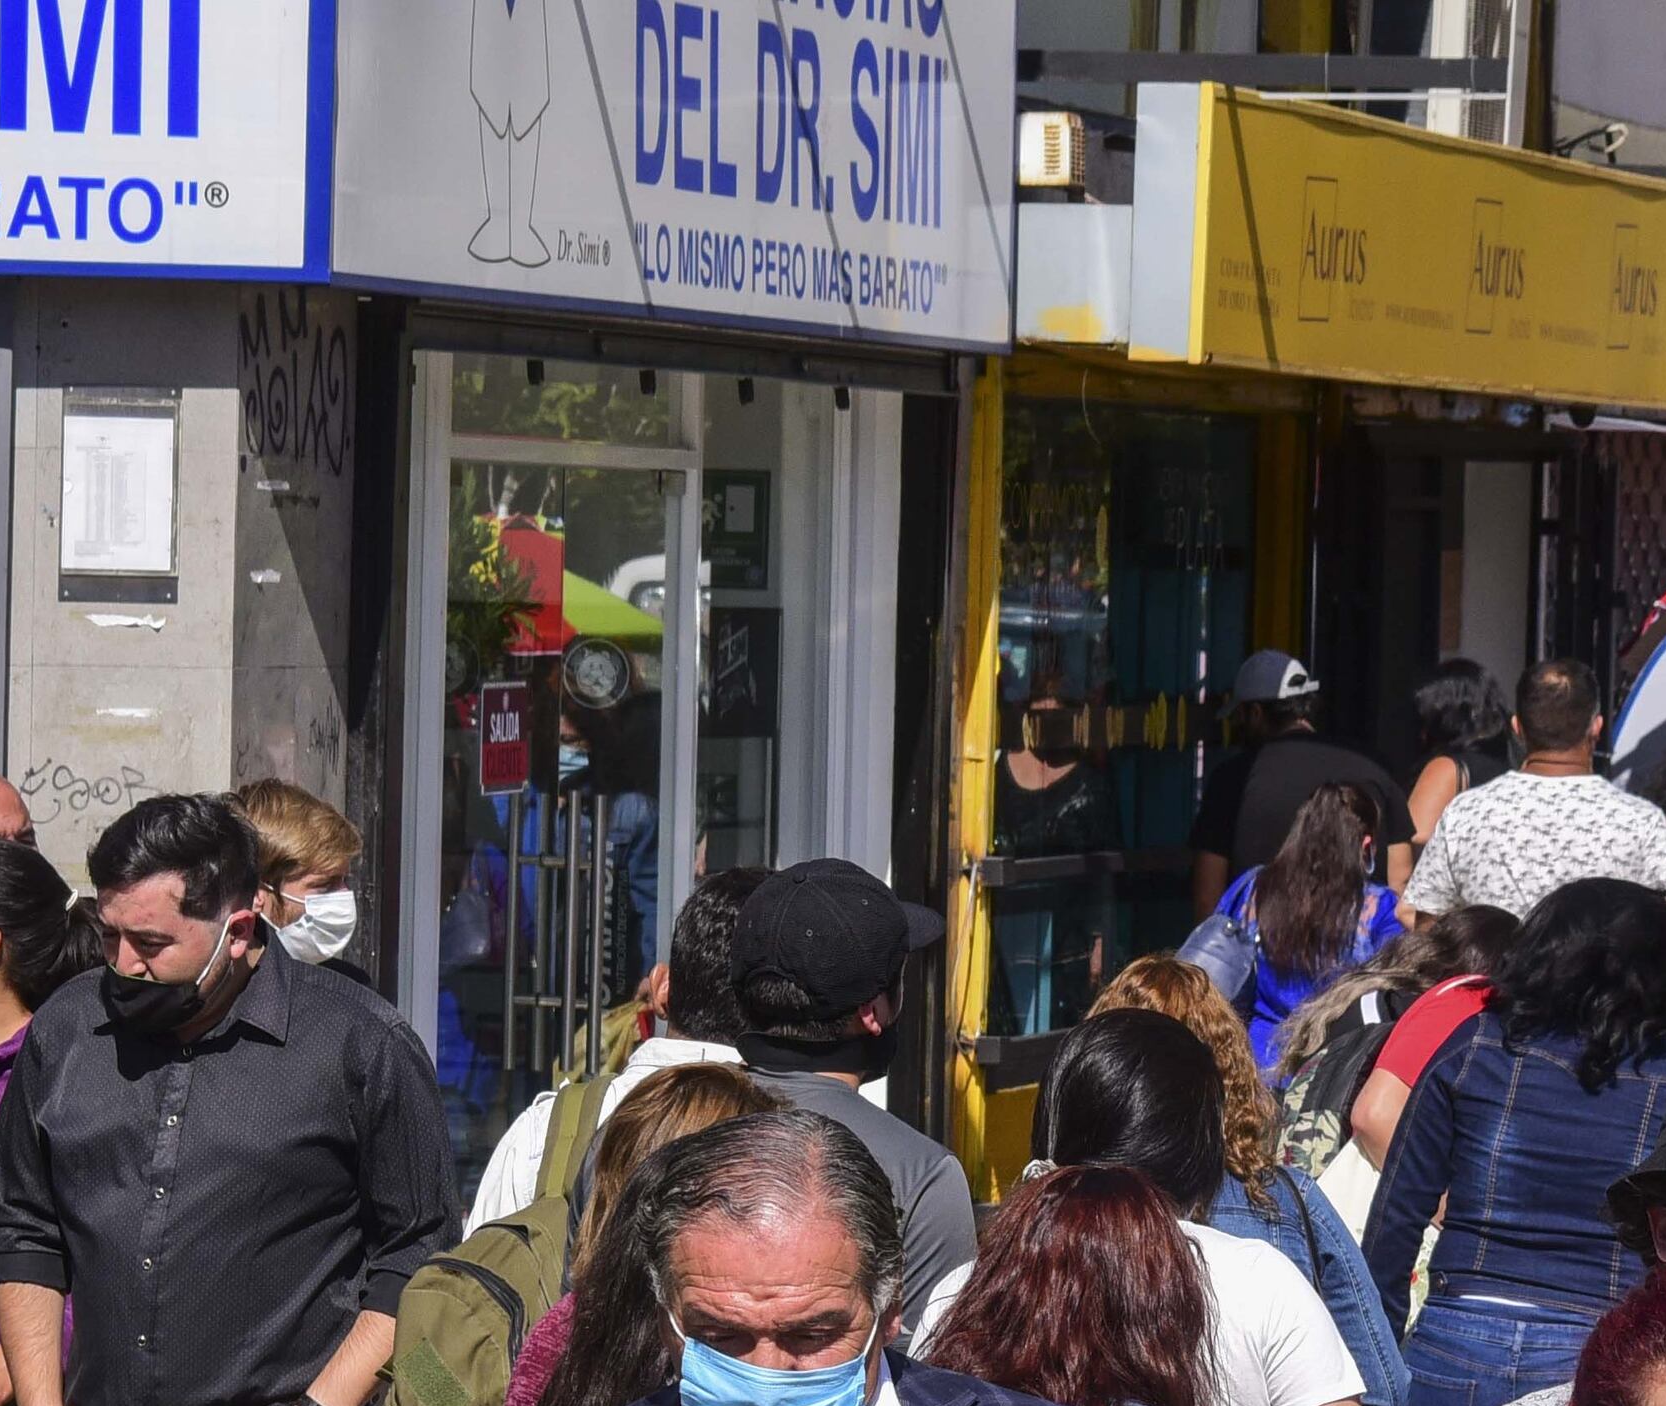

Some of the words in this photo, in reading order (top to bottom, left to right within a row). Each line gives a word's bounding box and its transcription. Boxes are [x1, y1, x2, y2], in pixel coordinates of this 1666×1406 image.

[635, 0, 737, 198] DEL
[755, 19, 833, 213] DR.
[850, 38, 942, 229] SIMI
[557, 229, 574, 262] Dr.
[576, 233, 600, 266] Simi
[678, 228, 745, 292] MISMO
[752, 238, 806, 300] PERO
[813, 246, 853, 305] MAS
[1305, 208, 1367, 285] Aurus
[1474, 231, 1526, 300] Aurus
[1615, 255, 1658, 317] Aurus
[490, 712, 521, 744] SALIDA
